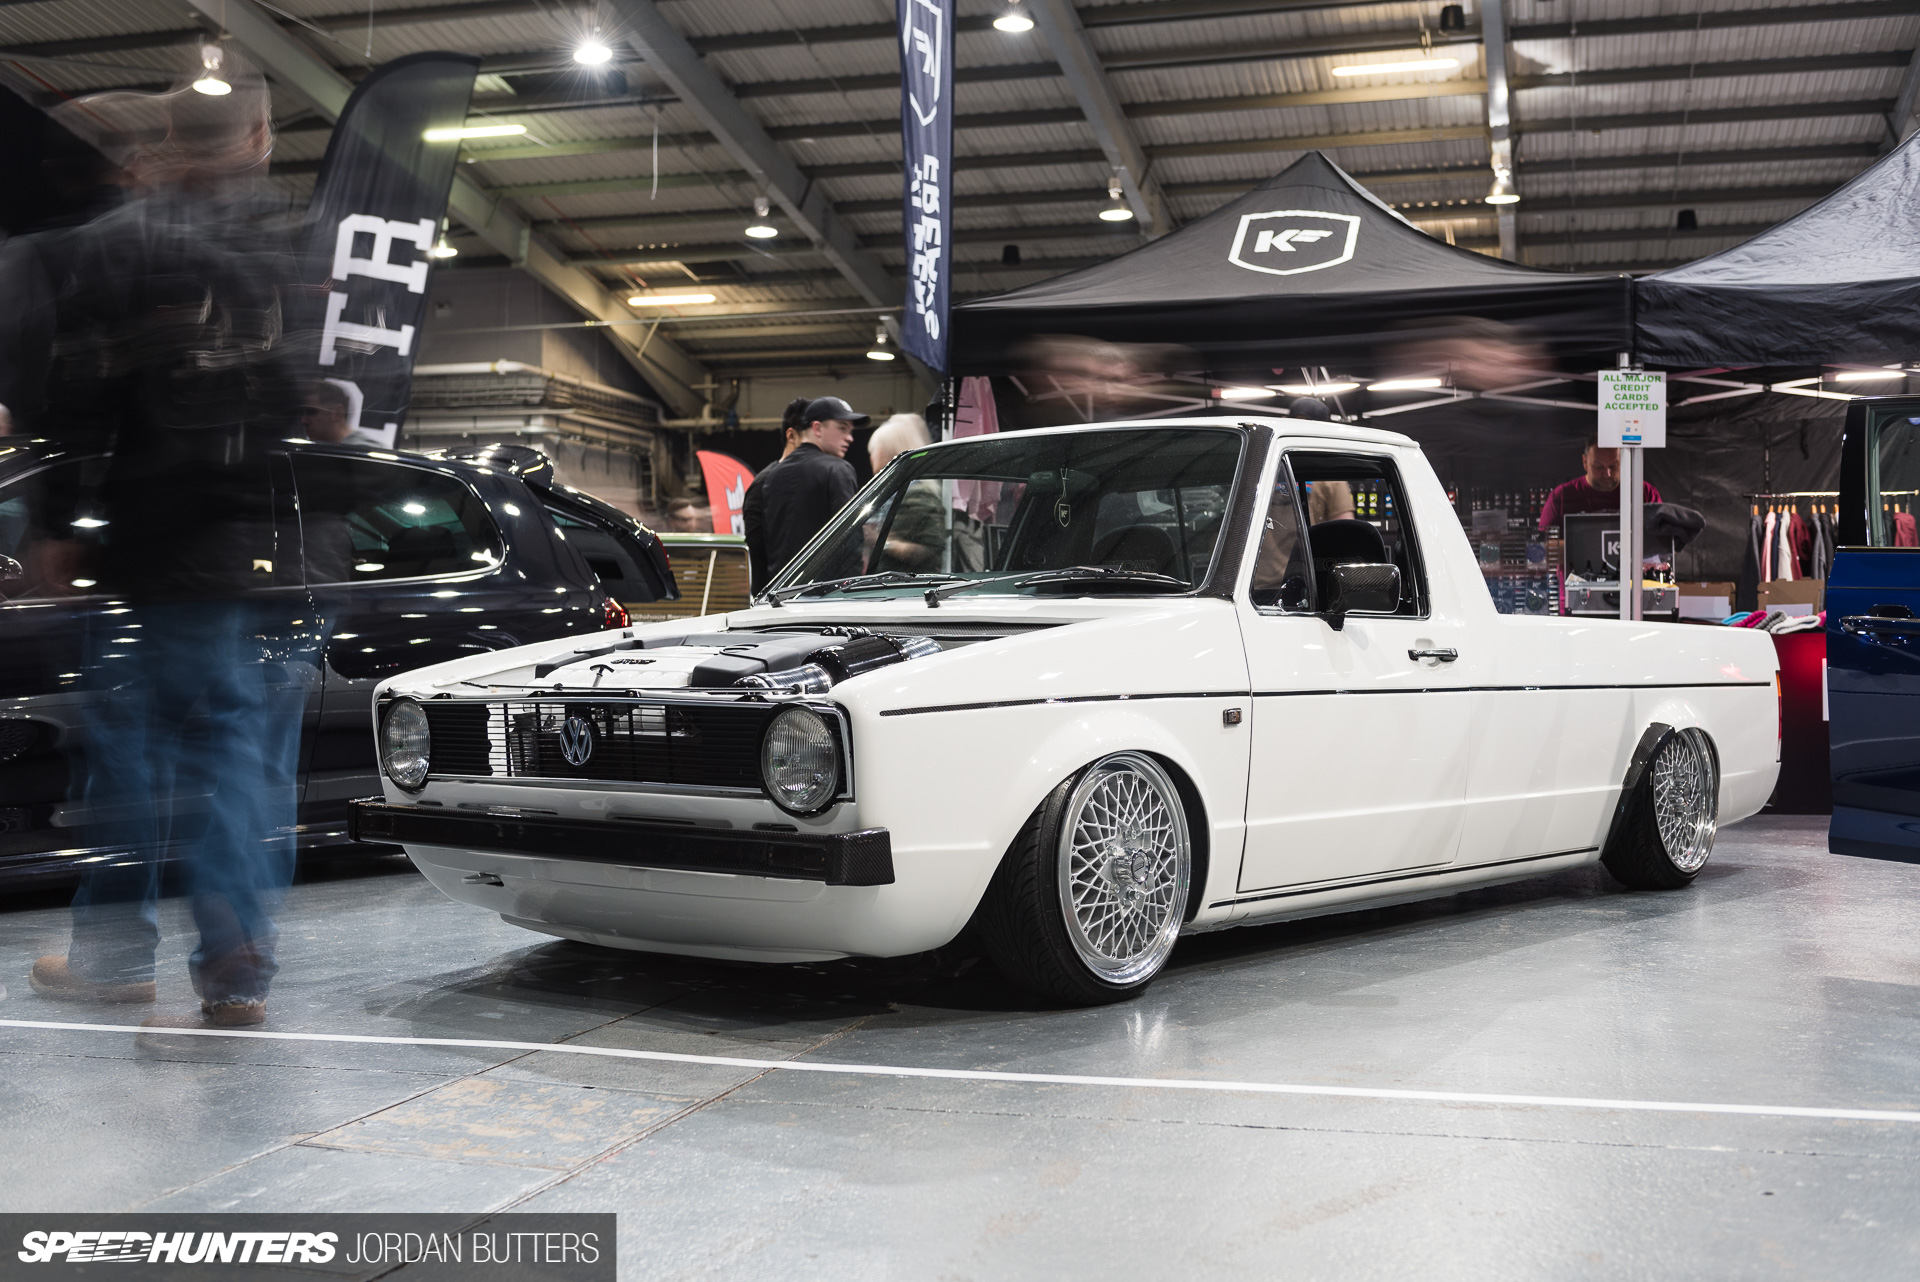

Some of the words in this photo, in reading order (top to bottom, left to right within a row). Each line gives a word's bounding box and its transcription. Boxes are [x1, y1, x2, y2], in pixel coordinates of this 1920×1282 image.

[1603, 374, 1622, 382] ALL
[1625, 375, 1662, 383] MAJOR
[1613, 384, 1651, 392] CREDIT
[1614, 393, 1649, 401] CARDS
[1604, 402, 1659, 411] ACCEPTED
[1607, 541, 1620, 555] K
[560, 716, 592, 766] VW
